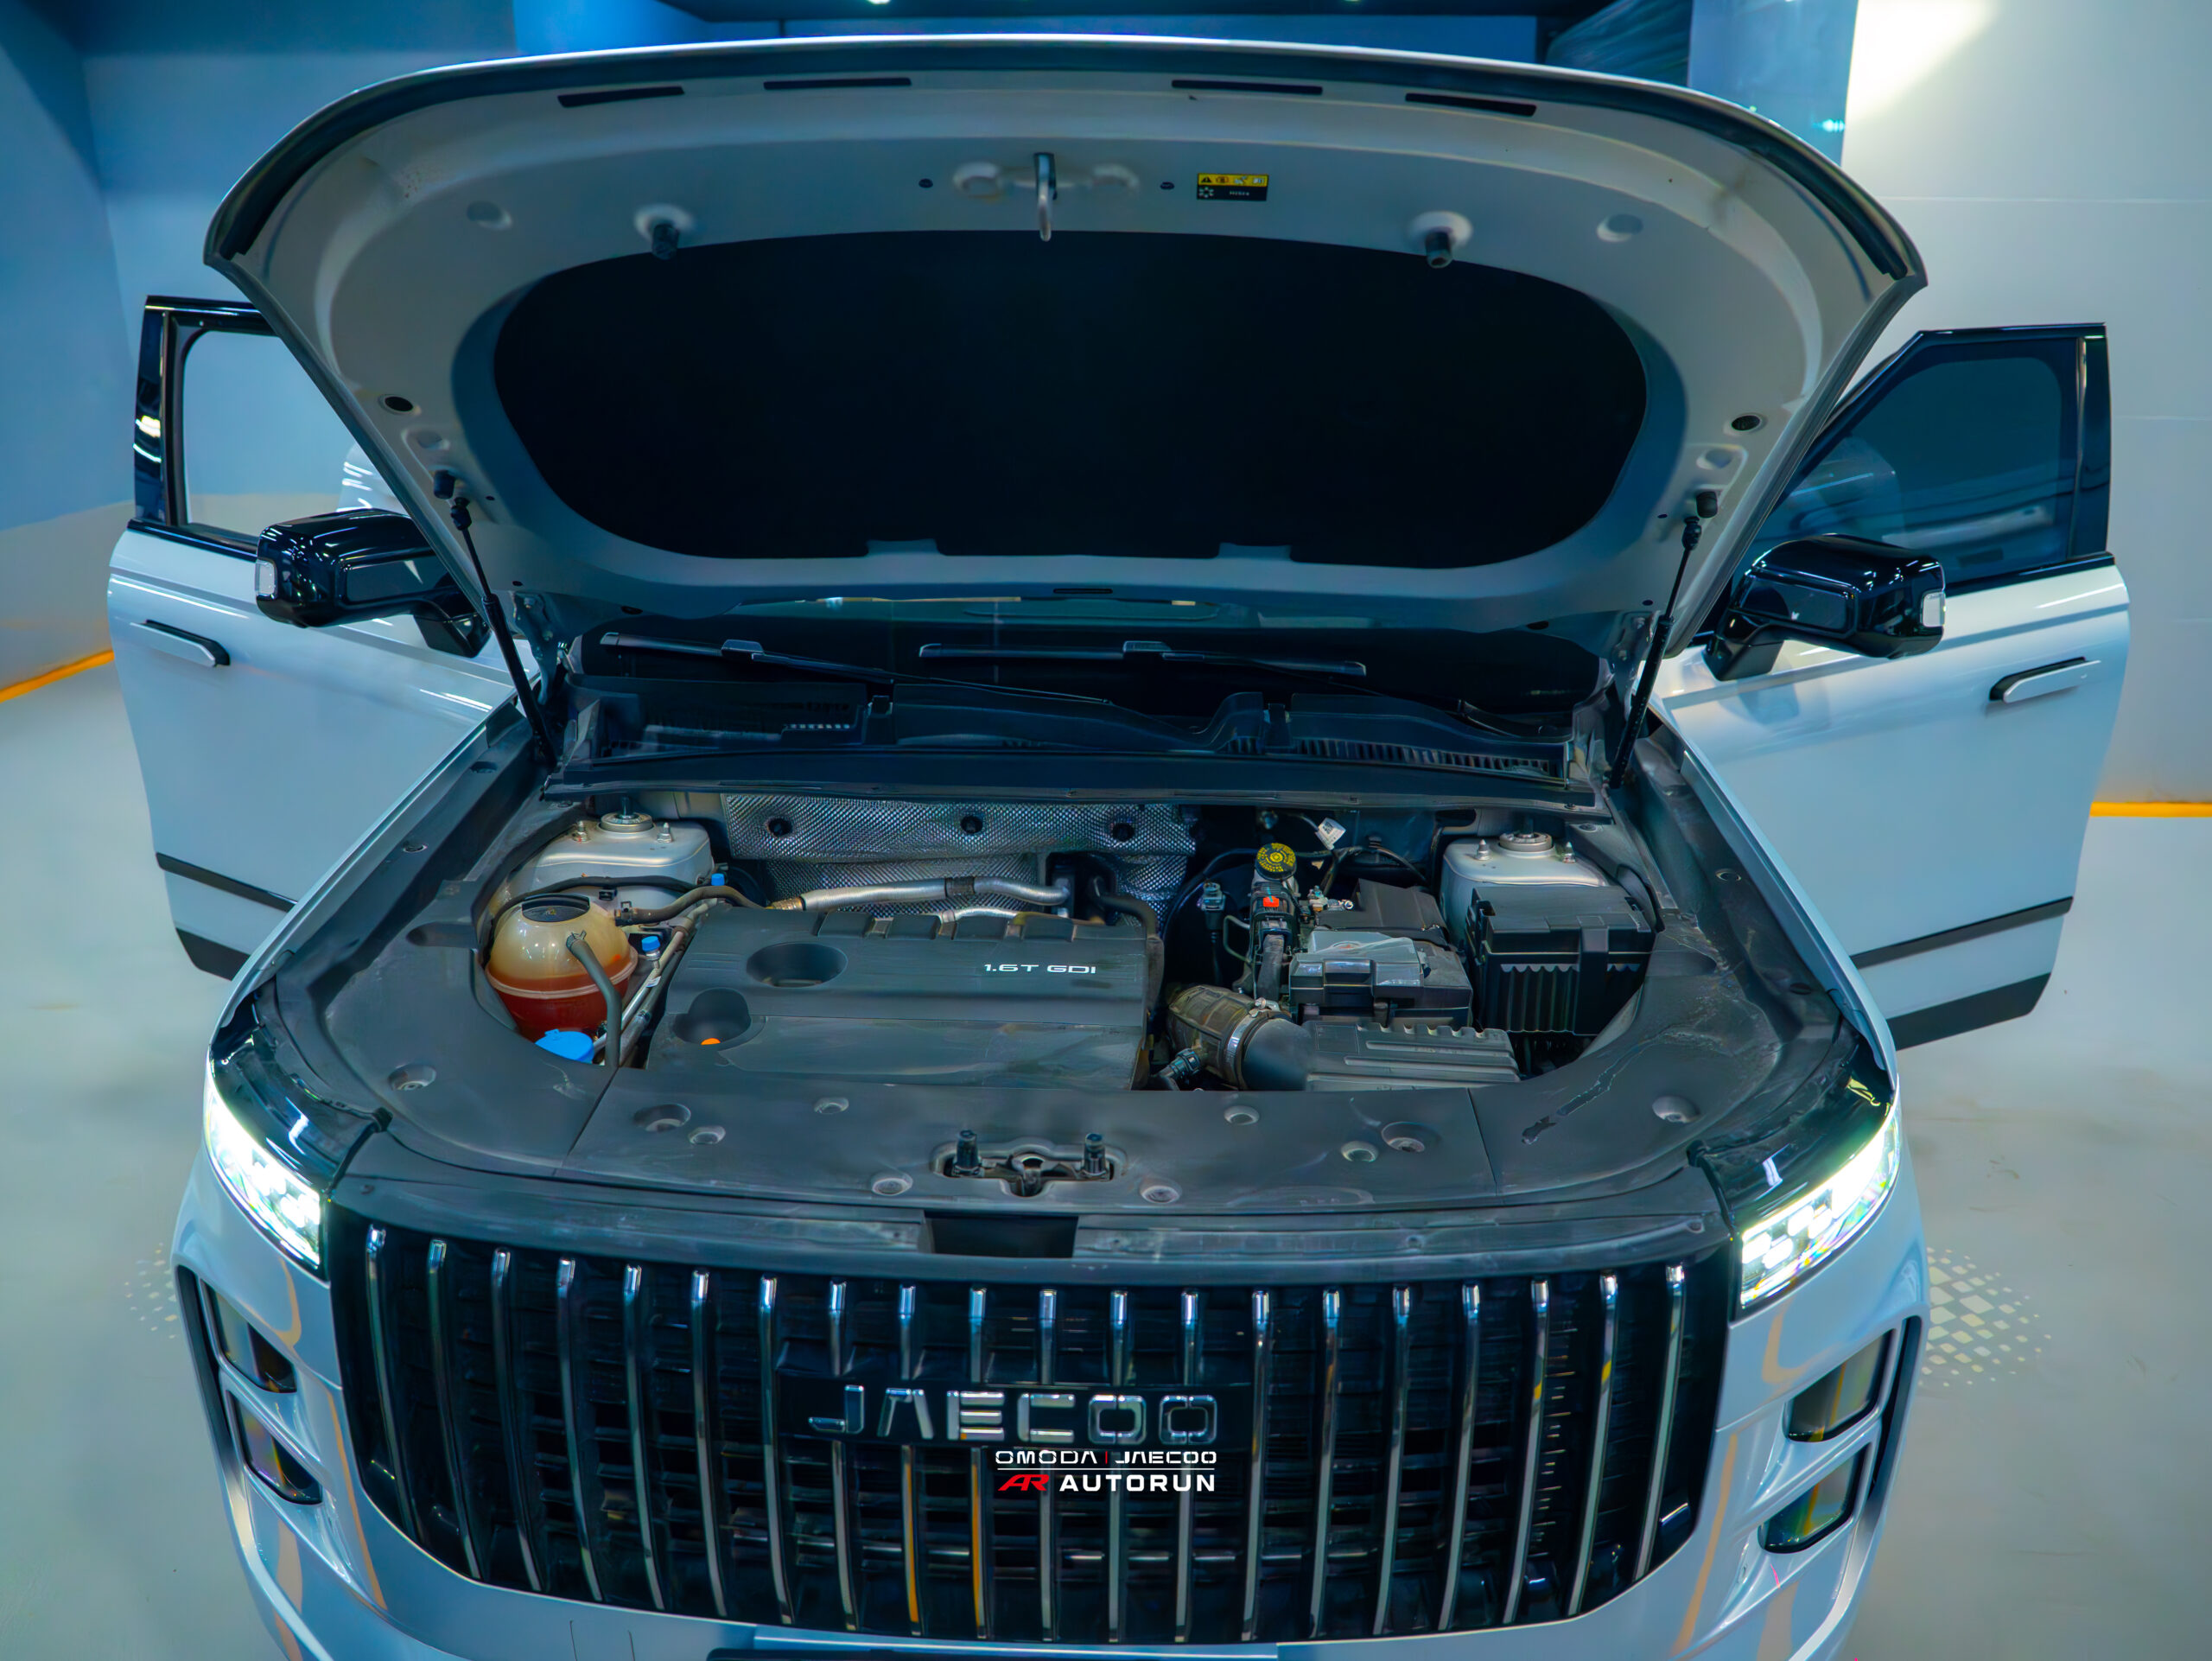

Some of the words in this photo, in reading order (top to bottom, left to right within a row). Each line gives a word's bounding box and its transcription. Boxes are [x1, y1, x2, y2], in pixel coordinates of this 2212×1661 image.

[984, 964, 1039, 972] 1.6T
[1046, 964, 1096, 974] GDI
[808, 1384, 1217, 1445] JAECOO
